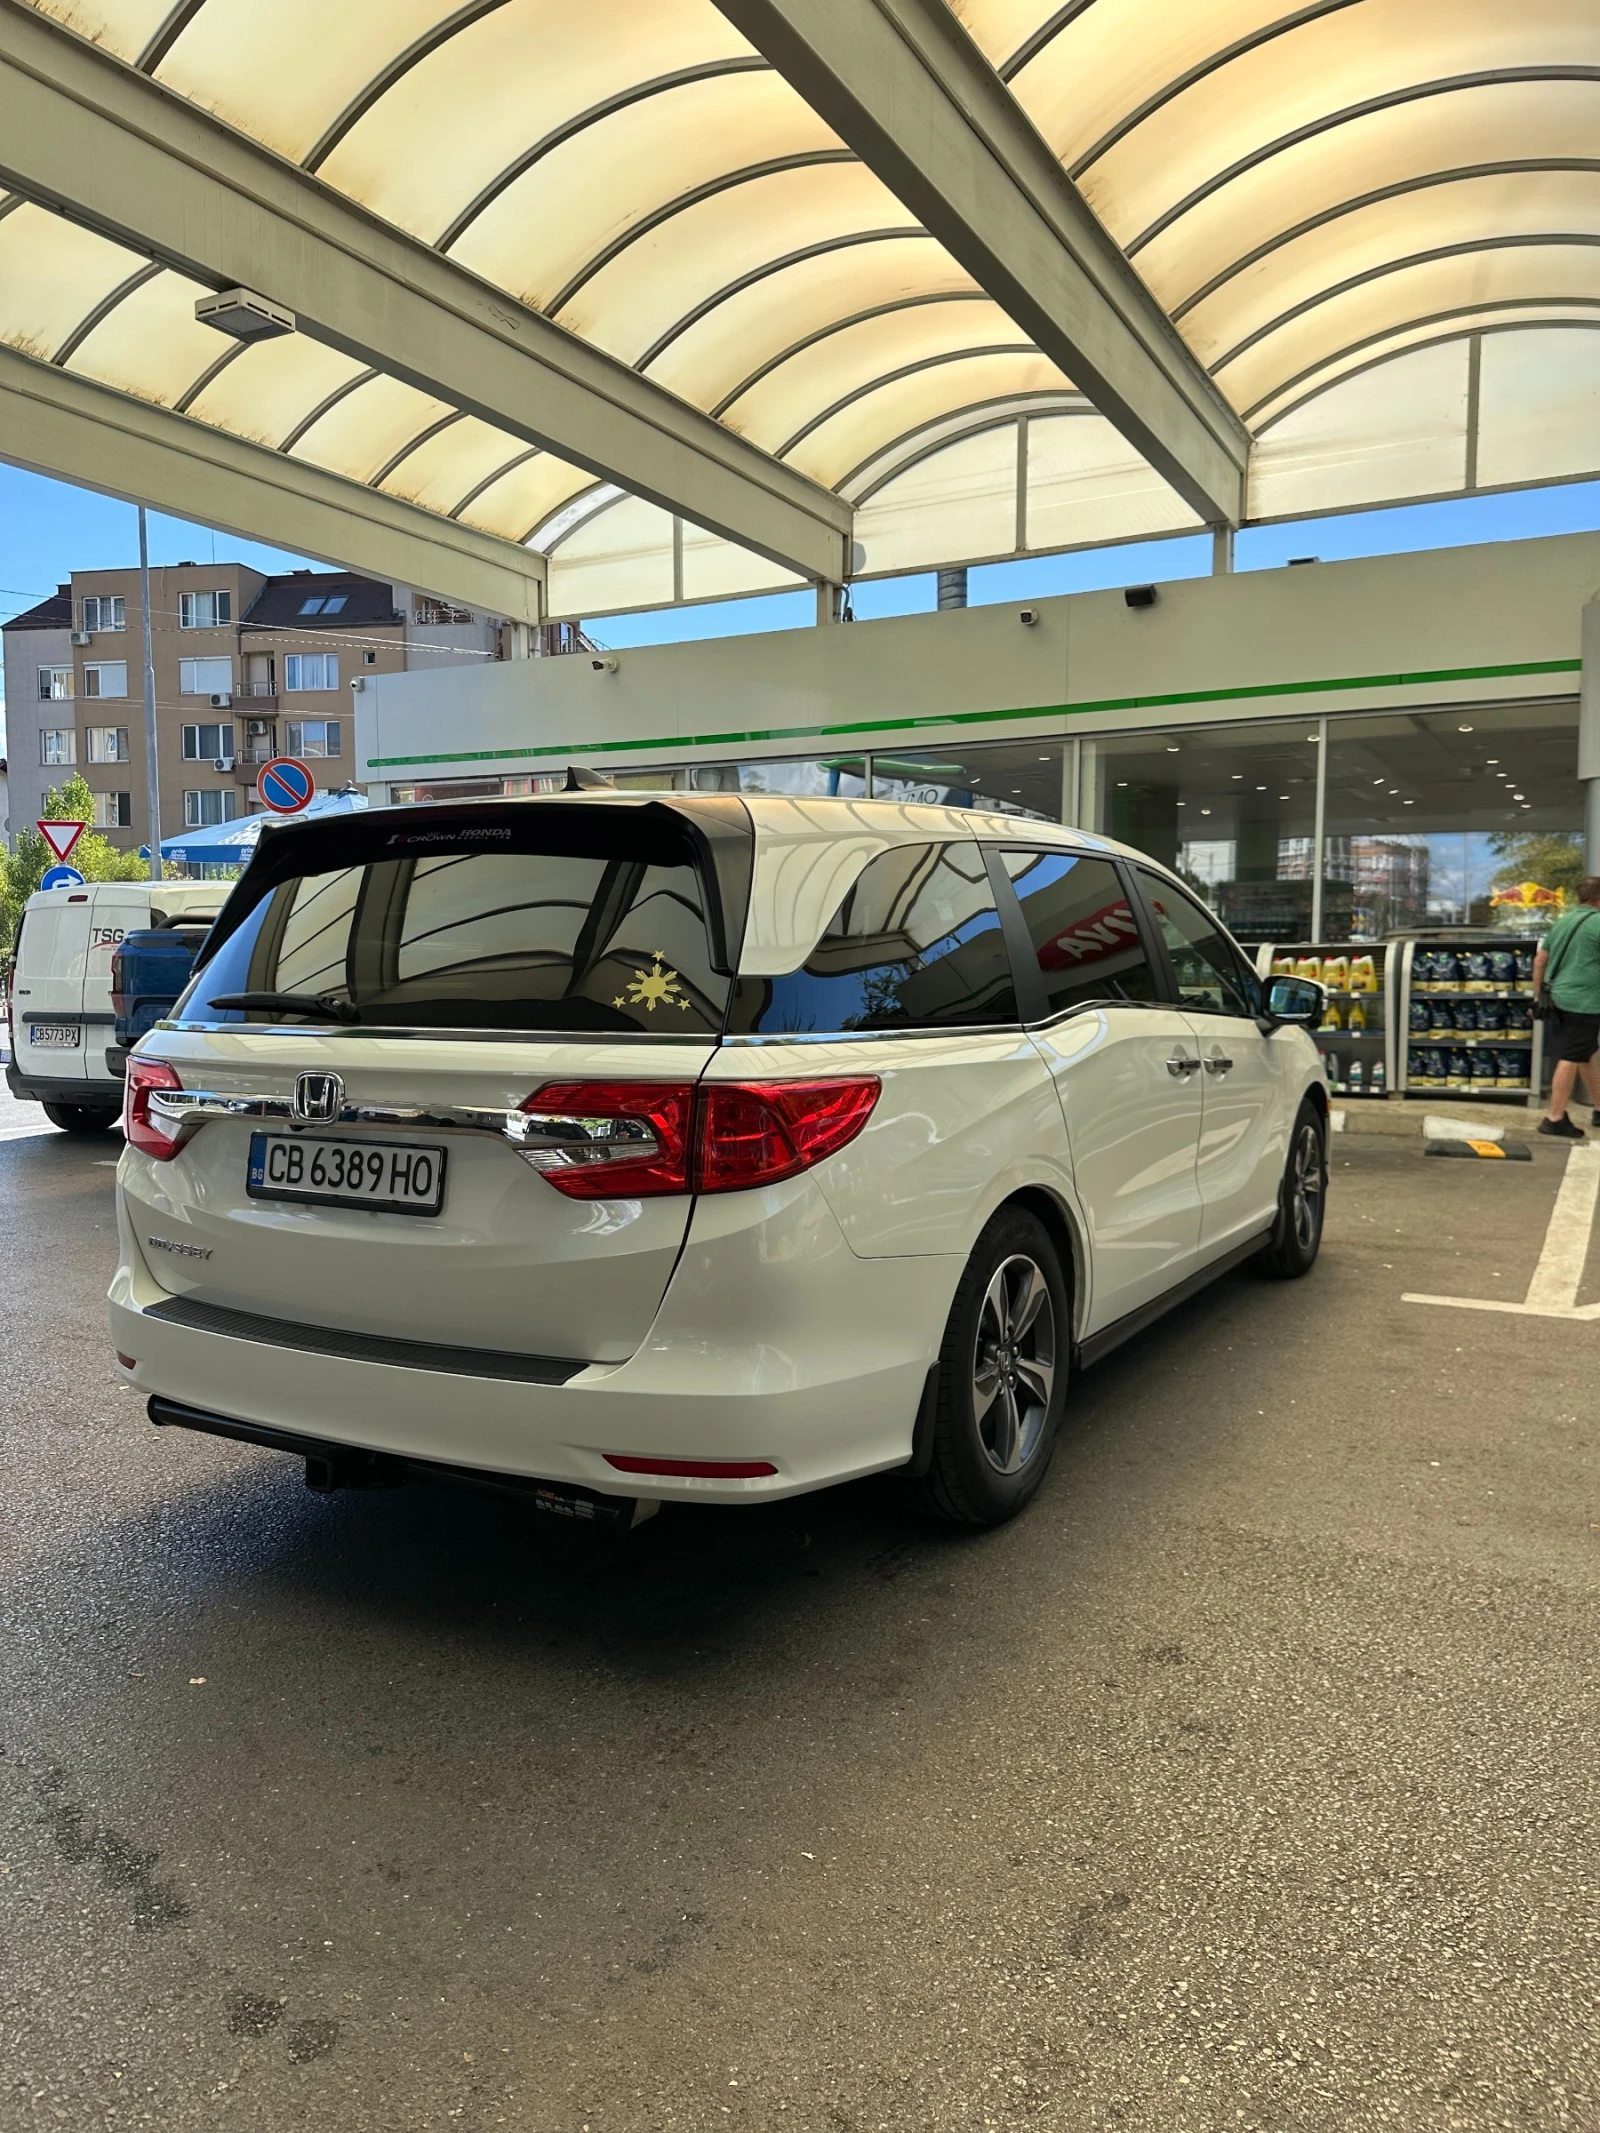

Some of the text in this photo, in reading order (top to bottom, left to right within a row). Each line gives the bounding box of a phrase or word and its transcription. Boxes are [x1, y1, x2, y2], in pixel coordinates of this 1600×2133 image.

[407, 834, 457, 843] CROWN
[460, 828, 512, 836] HONDA
[92, 928, 124, 943] TSG
[251, 1168, 264, 1180] BG
[268, 1143, 304, 1184] CB
[310, 1147, 384, 1192] 6389
[148, 1235, 213, 1260] ODYSSEY
